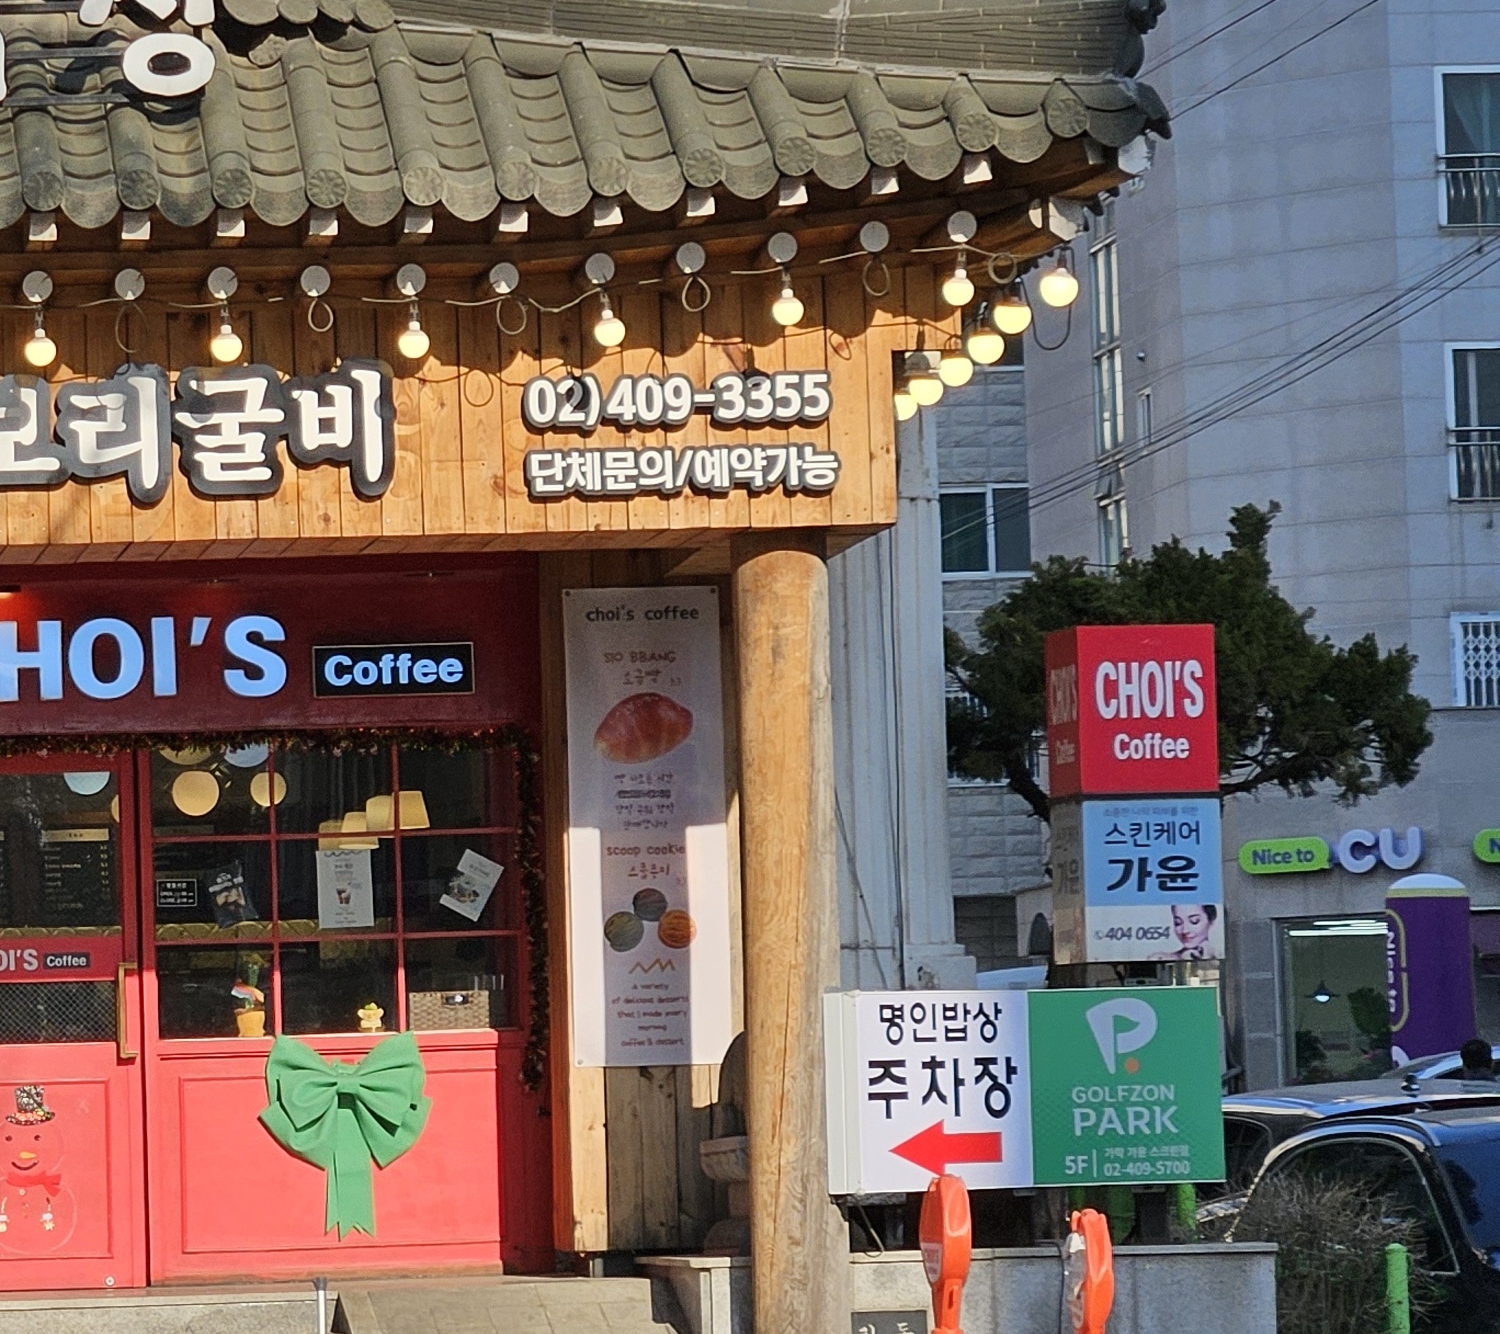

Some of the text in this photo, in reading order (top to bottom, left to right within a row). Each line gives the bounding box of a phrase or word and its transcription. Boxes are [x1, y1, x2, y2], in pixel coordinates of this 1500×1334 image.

[526, 370, 831, 427] 02)409-3355
[528, 448, 840, 495] 단체문의/예약가능
[585, 605, 700, 623] choi's coffee
[323, 652, 465, 687] Coffee
[629, 650, 677, 664] BBANG
[1095, 659, 1205, 721] CHOI'S
[1114, 732, 1191, 761] Coffee
[1104, 820, 1201, 848] 스킨케어
[606, 846, 641, 857] scoop
[1251, 846, 1315, 866] Nice to
[1338, 826, 1422, 874] CU
[1106, 855, 1200, 893] 가윤
[1104, 926, 1133, 941] 404
[46, 953, 88, 968] Coffee
[878, 1001, 1003, 1045] 명인밥상
[867, 1055, 1019, 1120] 주차장
[1070, 1083, 1176, 1104] GOLFZON
[1071, 1104, 1179, 1137] PARK
[1064, 1155, 1089, 1175] 5F
